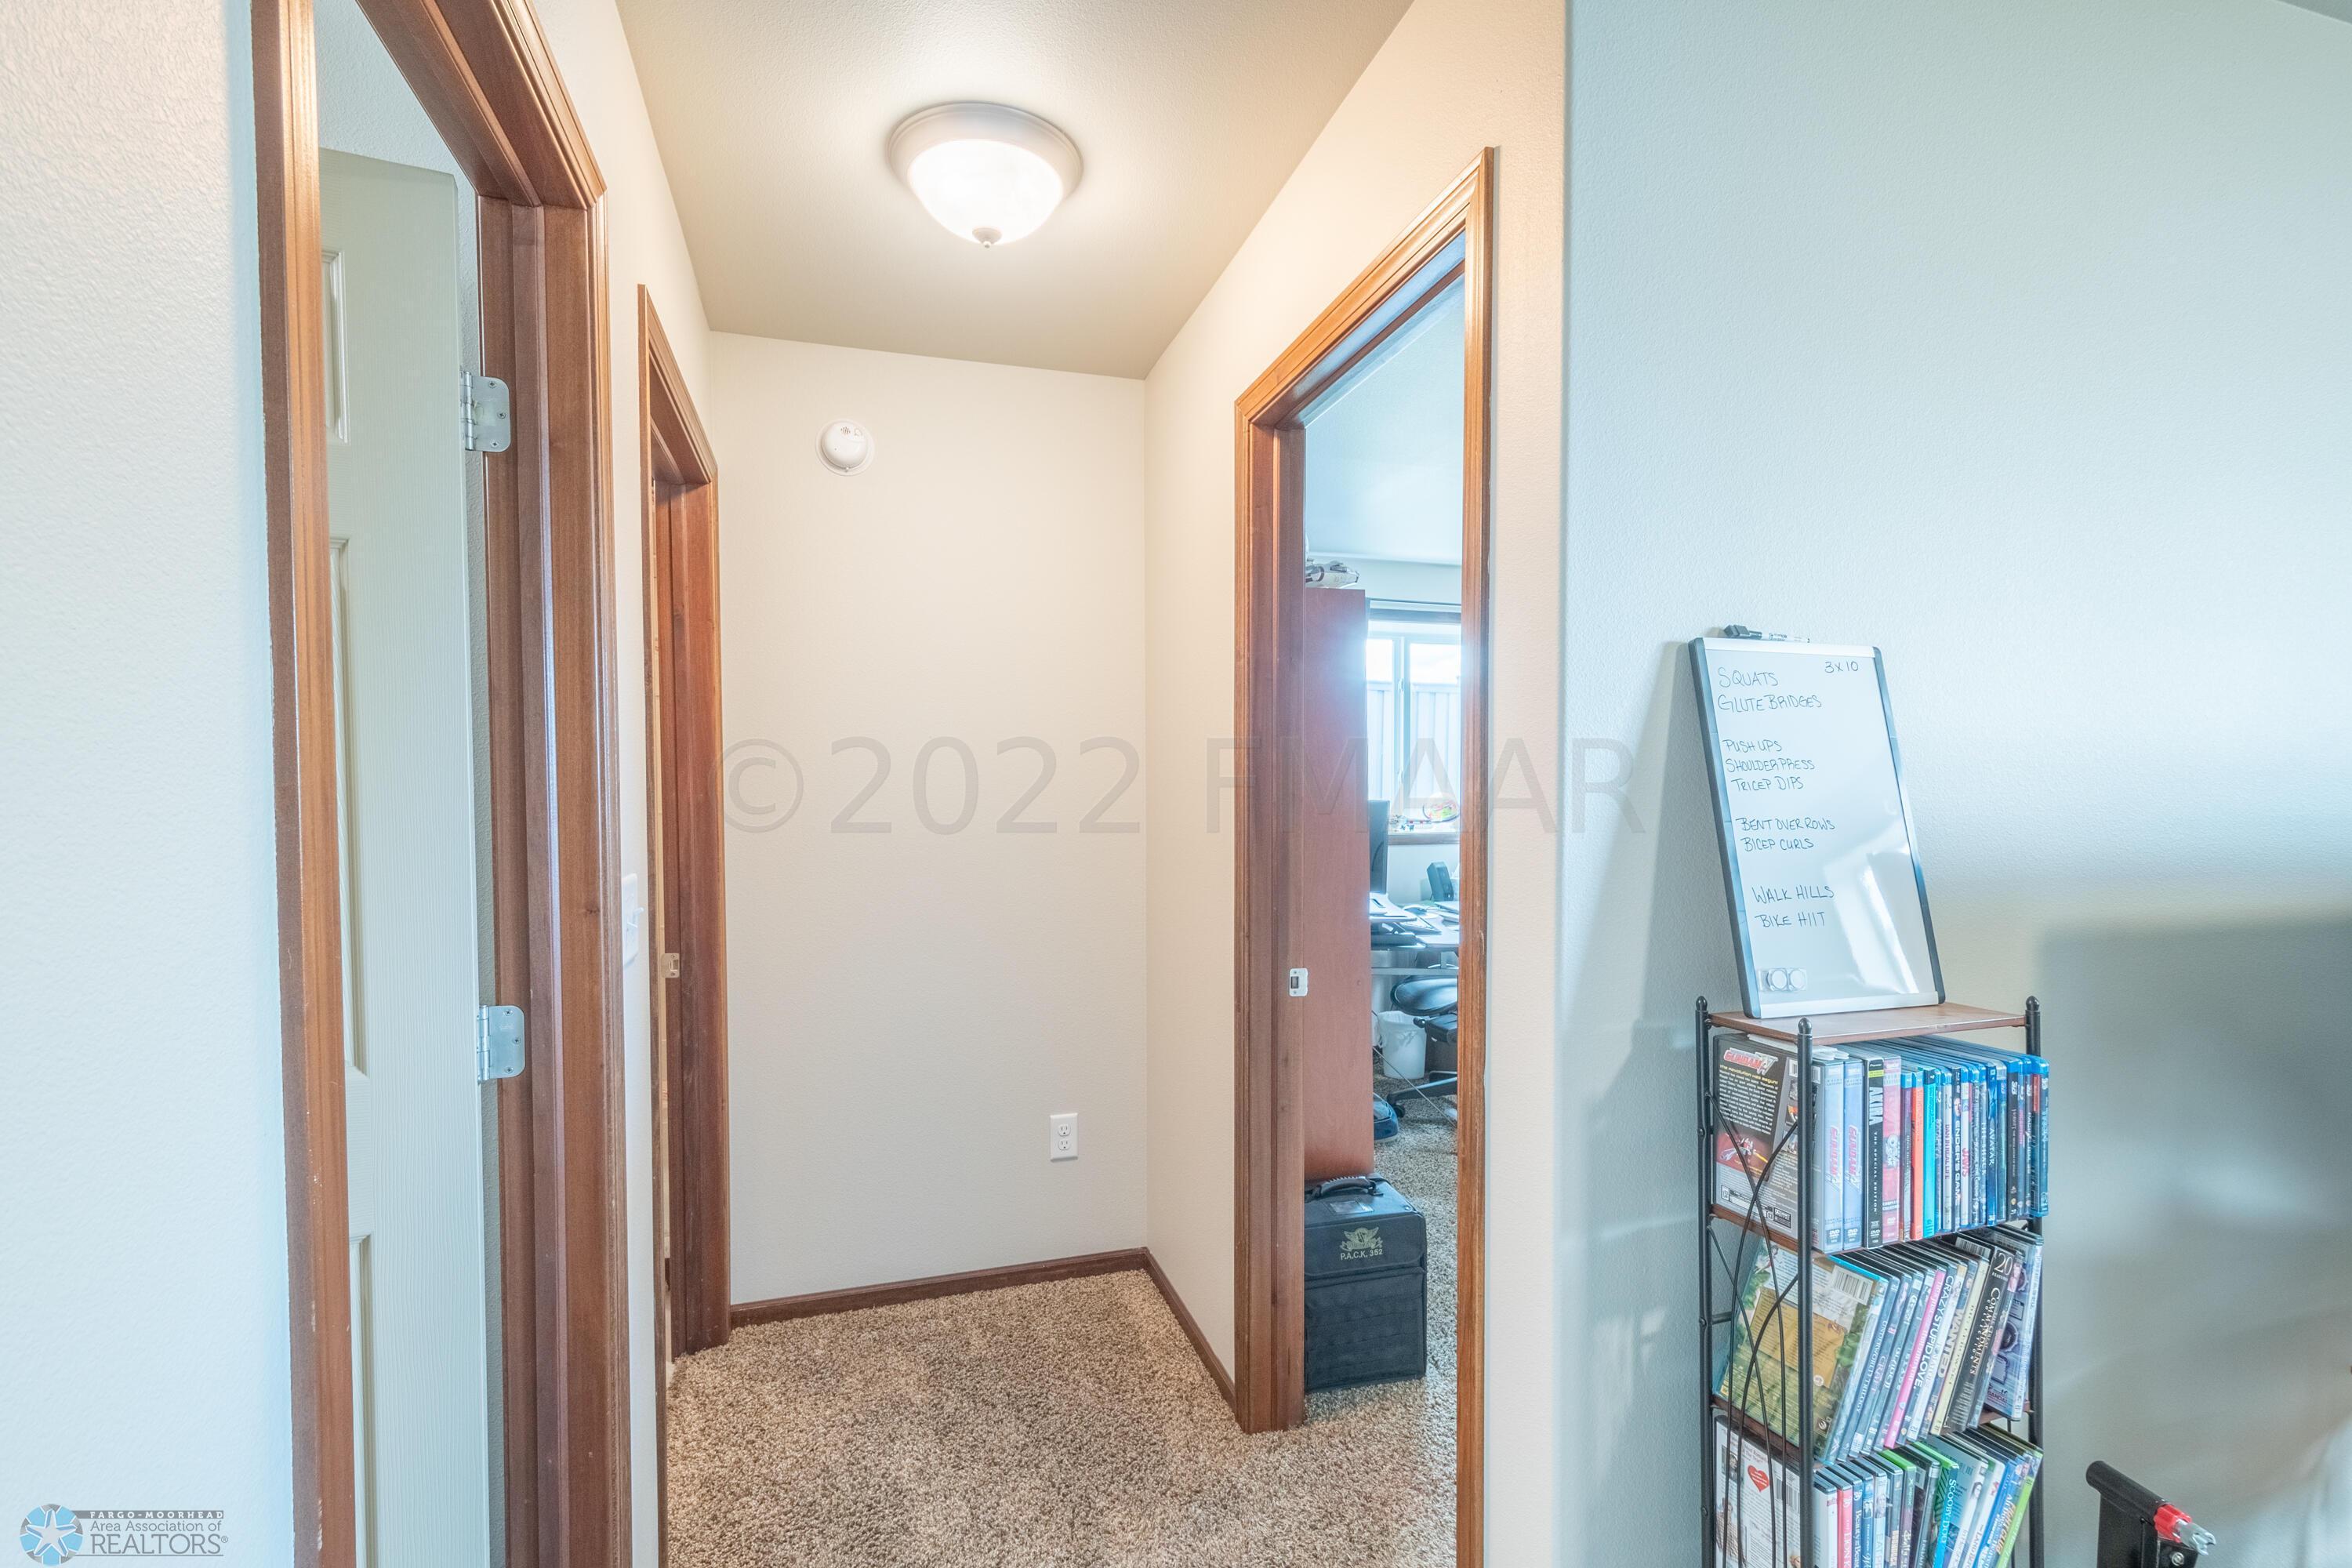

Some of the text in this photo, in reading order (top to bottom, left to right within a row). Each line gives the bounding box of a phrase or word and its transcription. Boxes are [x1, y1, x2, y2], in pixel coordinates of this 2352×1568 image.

[1718, 667, 1779, 688] SQUATS
[1717, 694, 1823, 713] GLUTE BRIDGES
[1725, 757, 1816, 773] SHOULDER PRESS
[1731, 775, 1804, 792] TRICEP DIPS
[1735, 817, 1836, 832] BENT OVER ROWS
[1740, 837, 1815, 852] BICEP CURLS
[1751, 884, 1835, 905] WALK HILLS
[1755, 911, 1826, 928] BIKE HIIT
[1868, 1087, 1883, 1126] AKIRA
[1369, 1248, 1384, 1257] 352
[1993, 1252, 2013, 1276] 20
[1937, 1274, 1954, 1317] CRAZY
[1926, 1313, 1941, 1355] STUPID
[1938, 1305, 1963, 1379] WANTED
